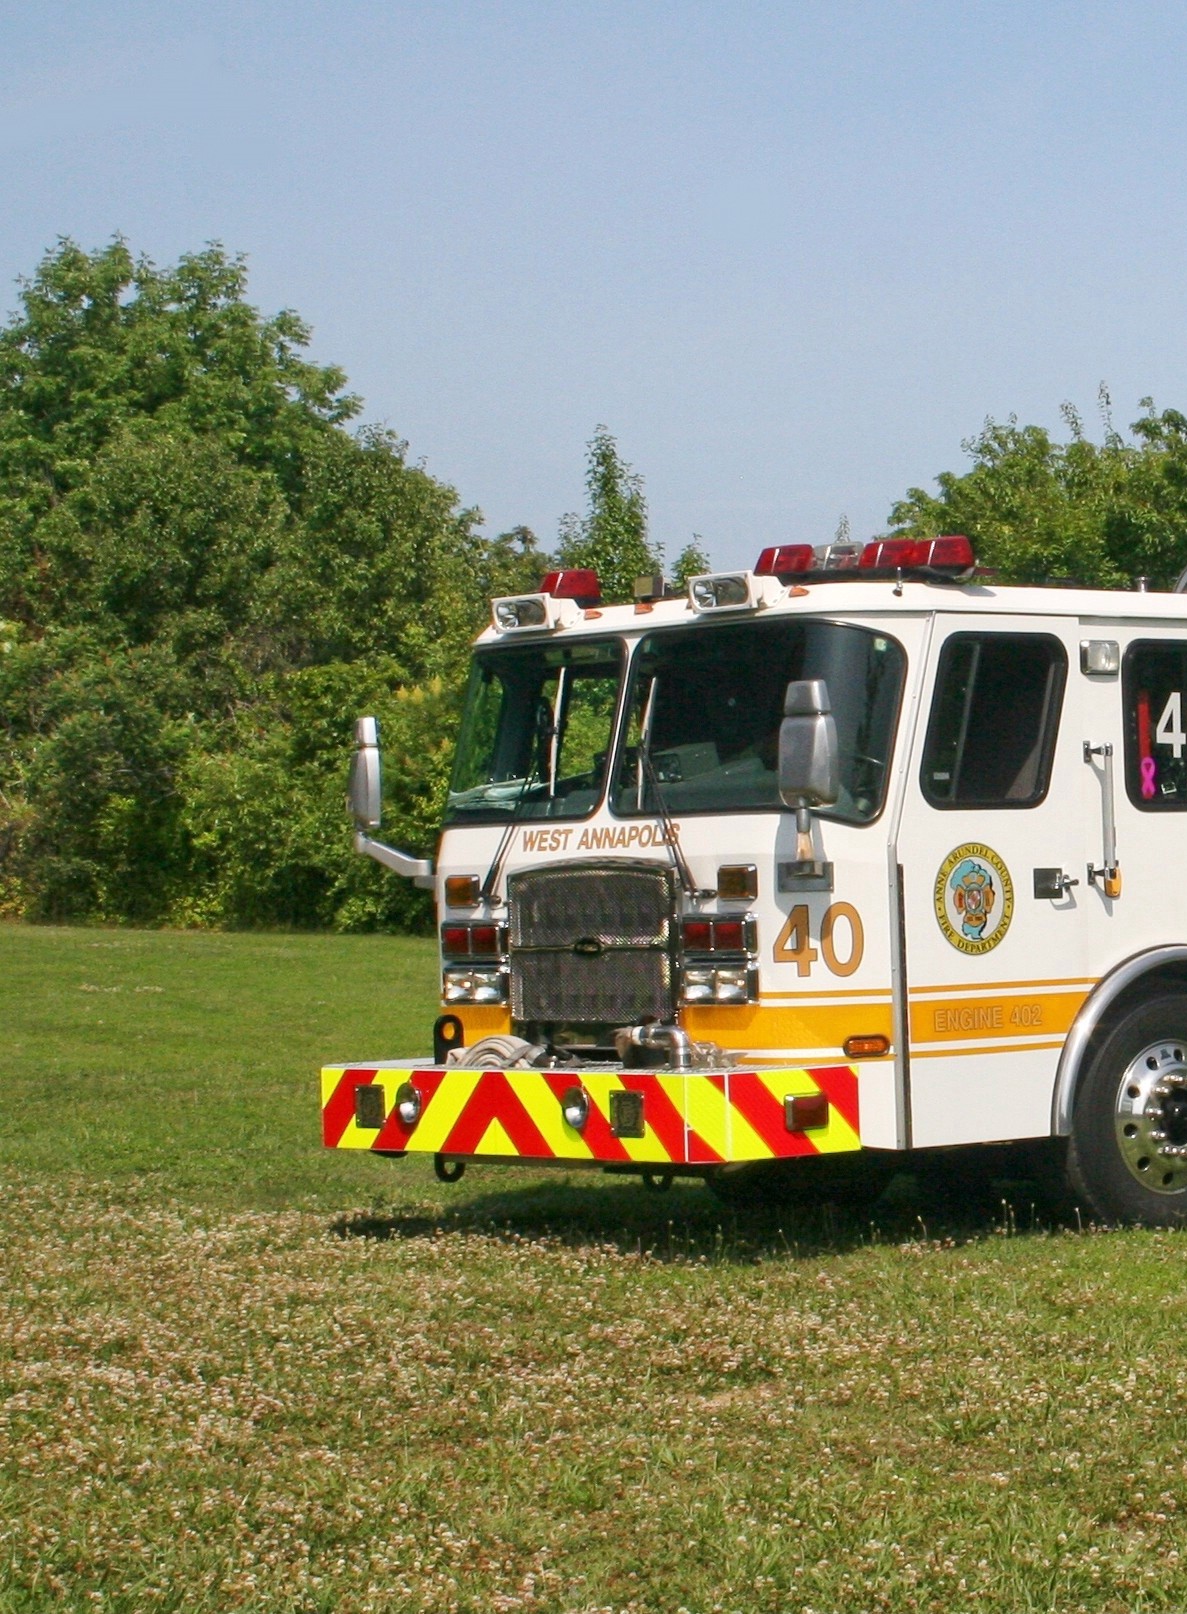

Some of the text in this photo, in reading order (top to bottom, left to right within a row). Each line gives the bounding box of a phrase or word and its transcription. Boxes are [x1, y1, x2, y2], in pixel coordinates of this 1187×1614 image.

[523, 828, 573, 852] WEST
[936, 870, 948, 902] ANNE
[947, 845, 989, 867] ARUNDEL
[991, 854, 1012, 902] COUNTY
[773, 901, 864, 977] 40
[938, 914, 1010, 953] FIRE DEPARTMENT
[934, 1004, 1042, 1033] ENGINE 402
